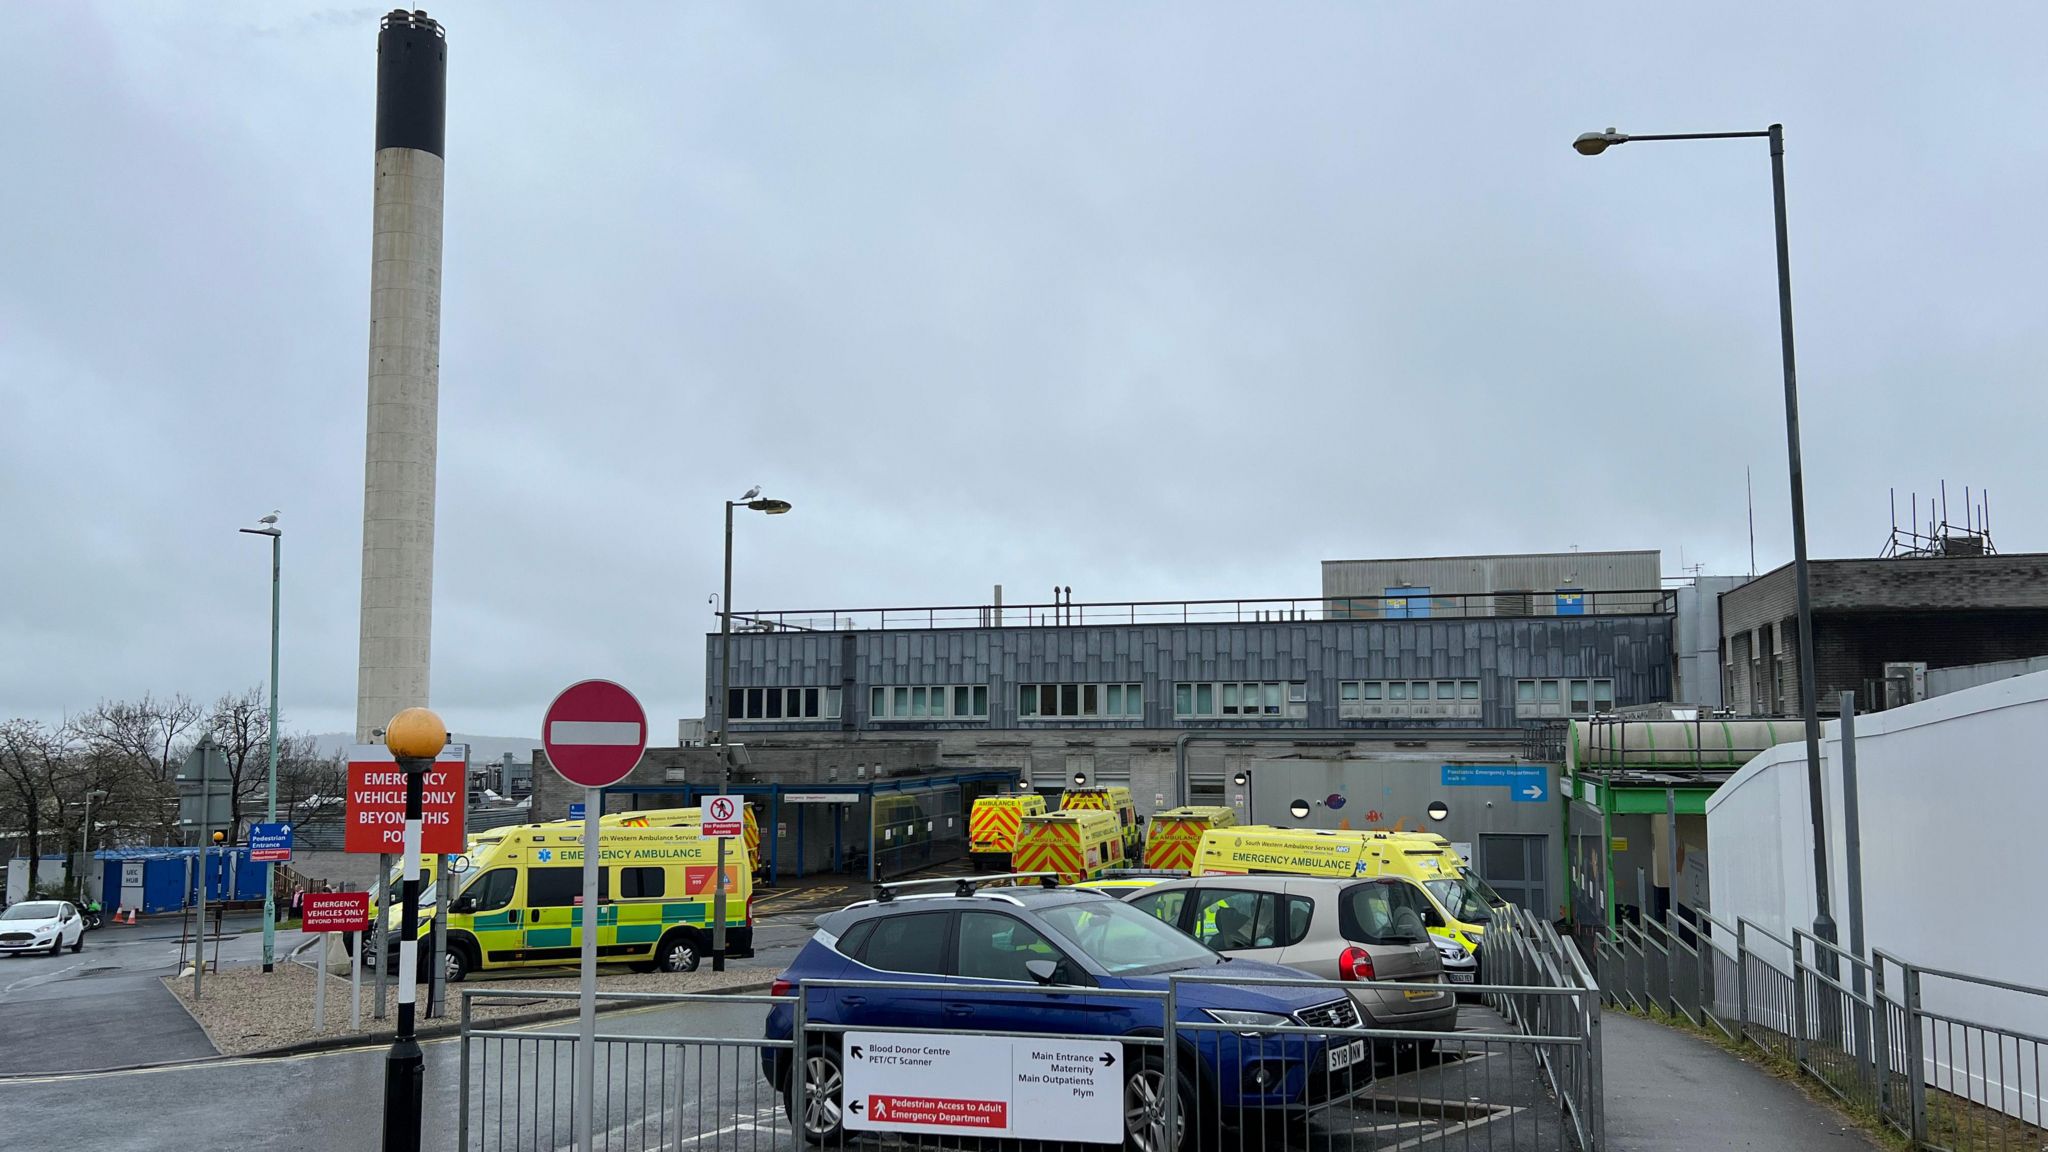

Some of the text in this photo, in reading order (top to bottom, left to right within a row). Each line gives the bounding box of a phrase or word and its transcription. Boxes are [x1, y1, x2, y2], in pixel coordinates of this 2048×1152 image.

[364, 772, 448, 785] EMERGNCY
[354, 792, 456, 804] VEHICLE ONLY
[359, 812, 450, 824] BEYON THIS
[383, 830, 424, 842] POI
[560, 849, 702, 860] EMEENCY AMBULANCE
[1233, 853, 1351, 869] EMERGENCY AMBULANCE
[869, 1044, 950, 1056] Blood Donor Centre
[869, 1056, 932, 1066] PET/CT Scanner
[1032, 1051, 1094, 1062] Main Entrance
[1051, 1064, 1094, 1076] Maternity
[1019, 1074, 1094, 1085] Main Outpatients
[1073, 1088, 1094, 1099] Plym
[892, 1099, 935, 1109] Pedestrian
[937, 1101, 964, 1111] Access
[978, 1103, 1002, 1112] Adult
[892, 1110, 990, 1124] Emergency Department
